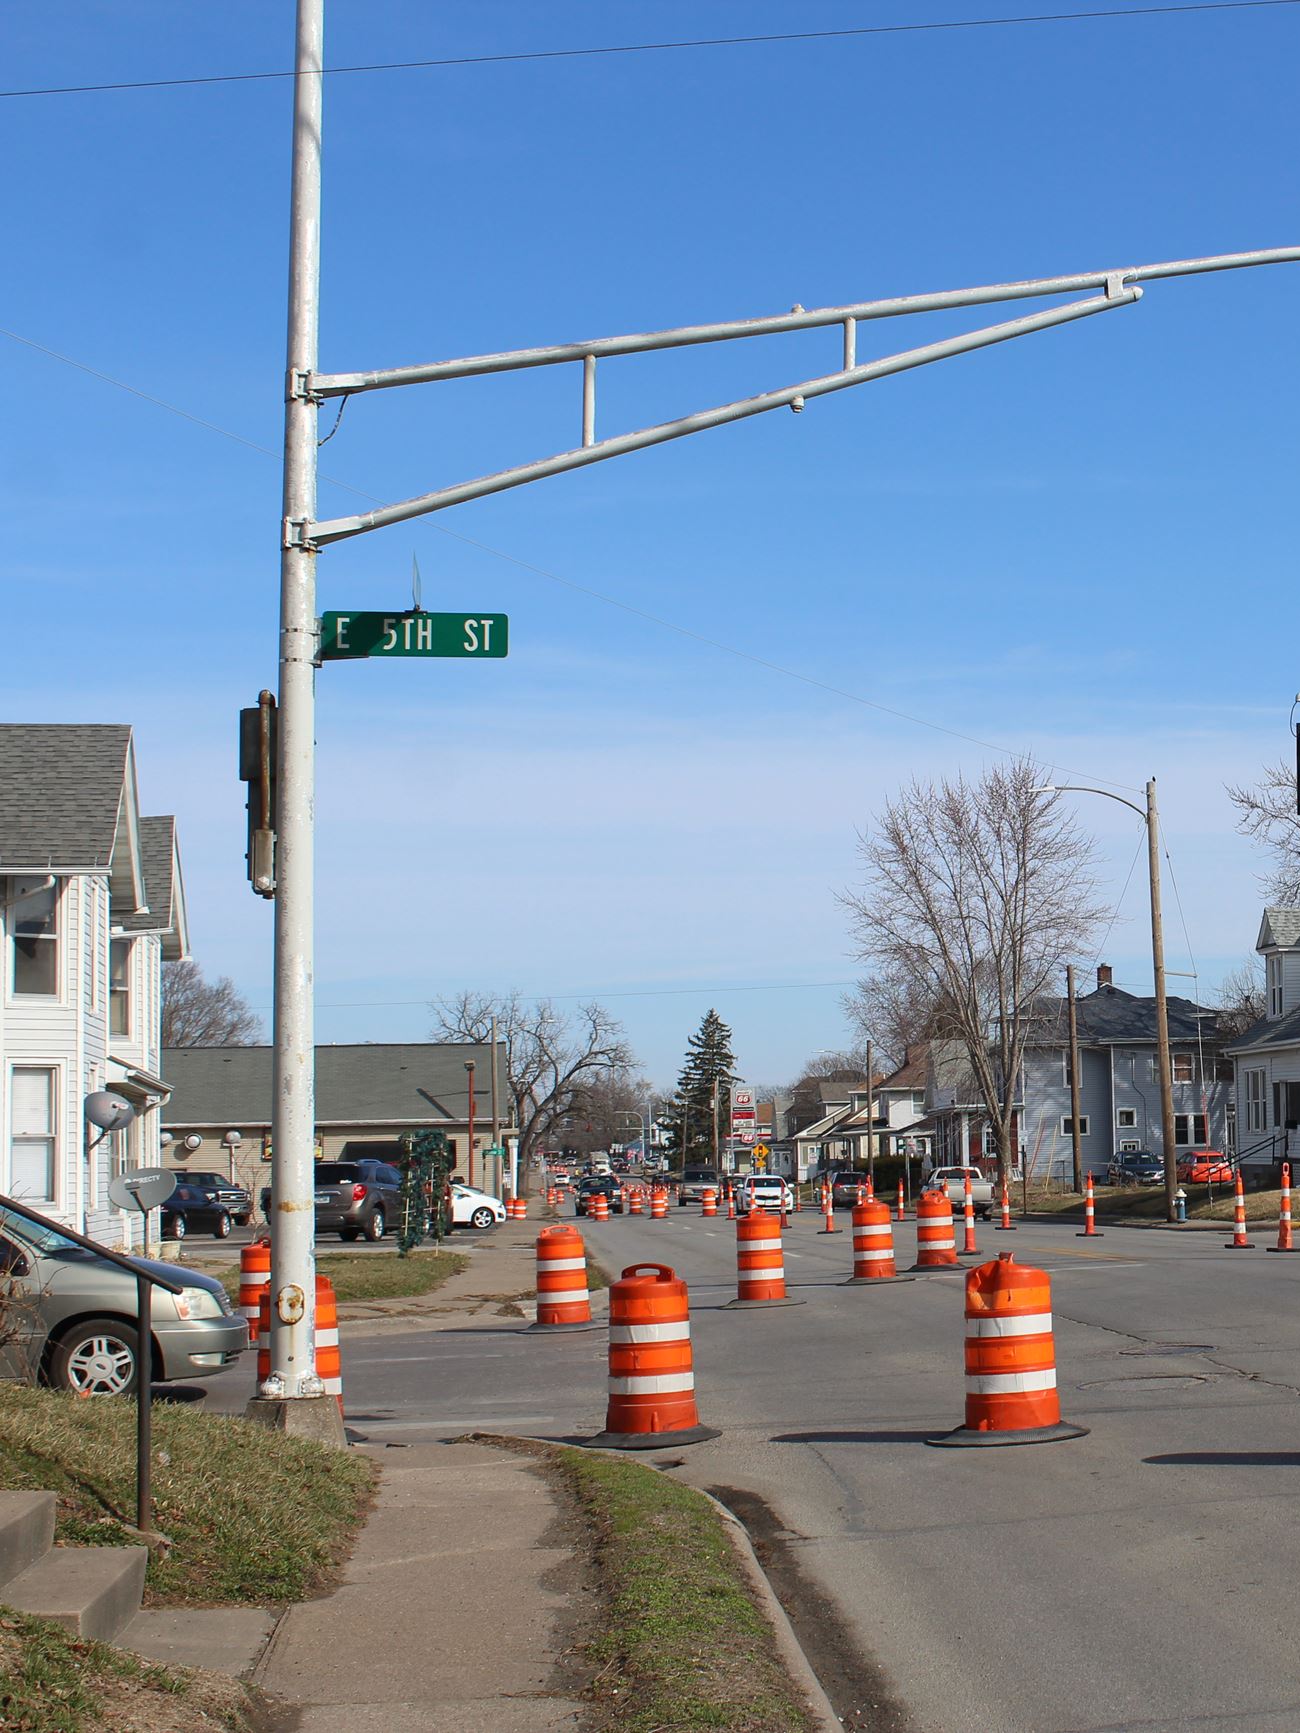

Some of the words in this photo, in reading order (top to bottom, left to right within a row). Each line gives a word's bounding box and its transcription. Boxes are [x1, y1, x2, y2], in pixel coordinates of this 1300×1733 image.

[337, 617, 350, 649] E
[383, 618, 433, 650] 5TH
[463, 619, 494, 652] ST
[737, 1095, 749, 1103] 66
